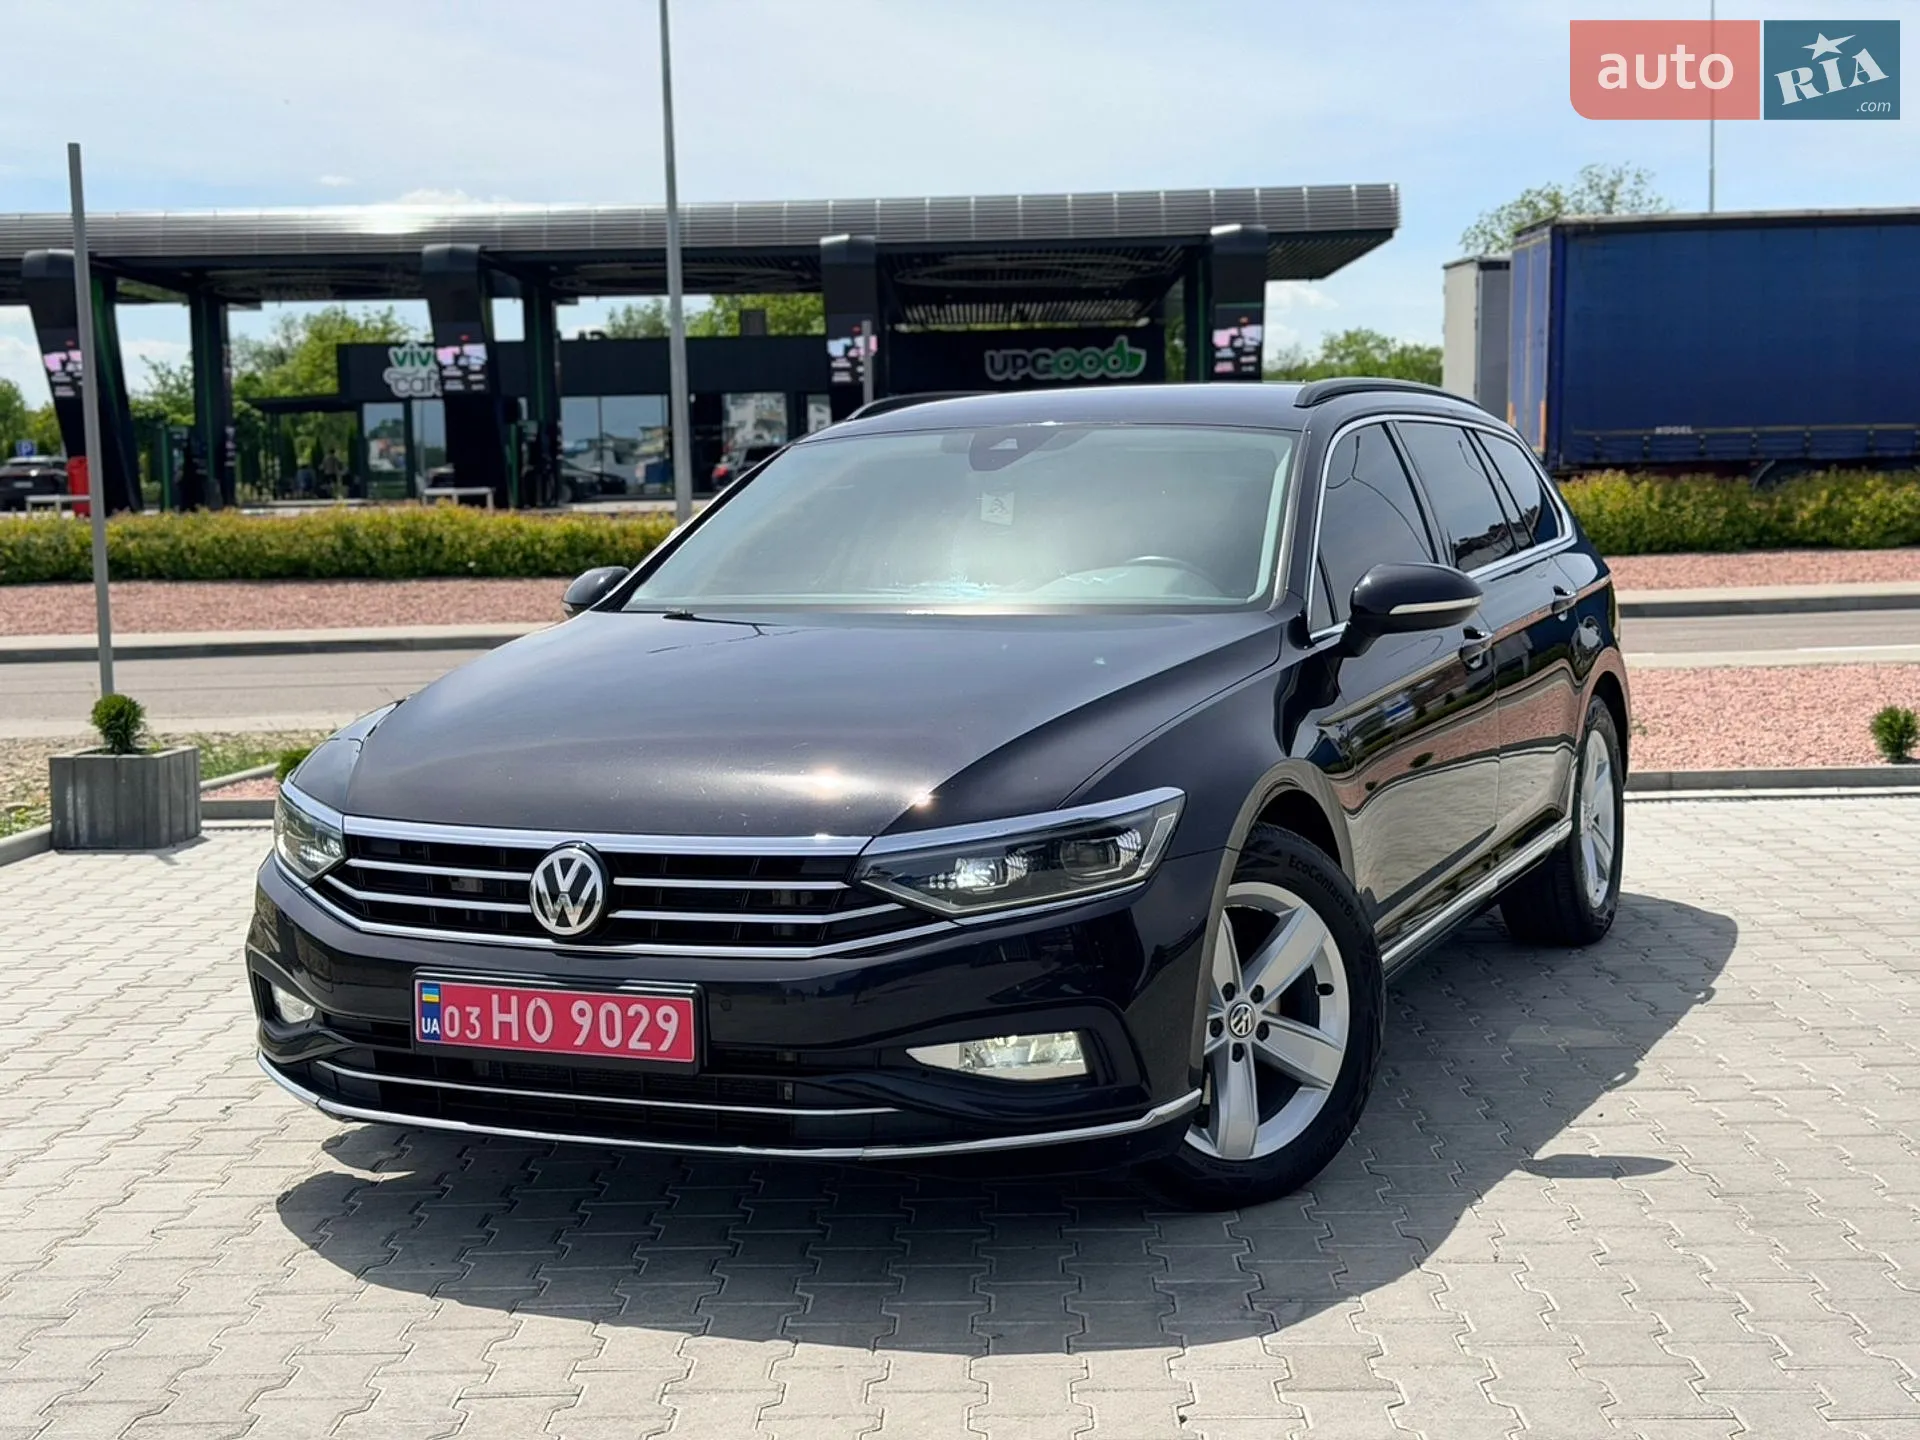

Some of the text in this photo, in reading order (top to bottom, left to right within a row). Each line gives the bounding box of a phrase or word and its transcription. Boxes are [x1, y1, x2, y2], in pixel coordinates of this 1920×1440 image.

[421, 1017, 440, 1034] UA
[444, 994, 679, 1052] 03 HO 9029
